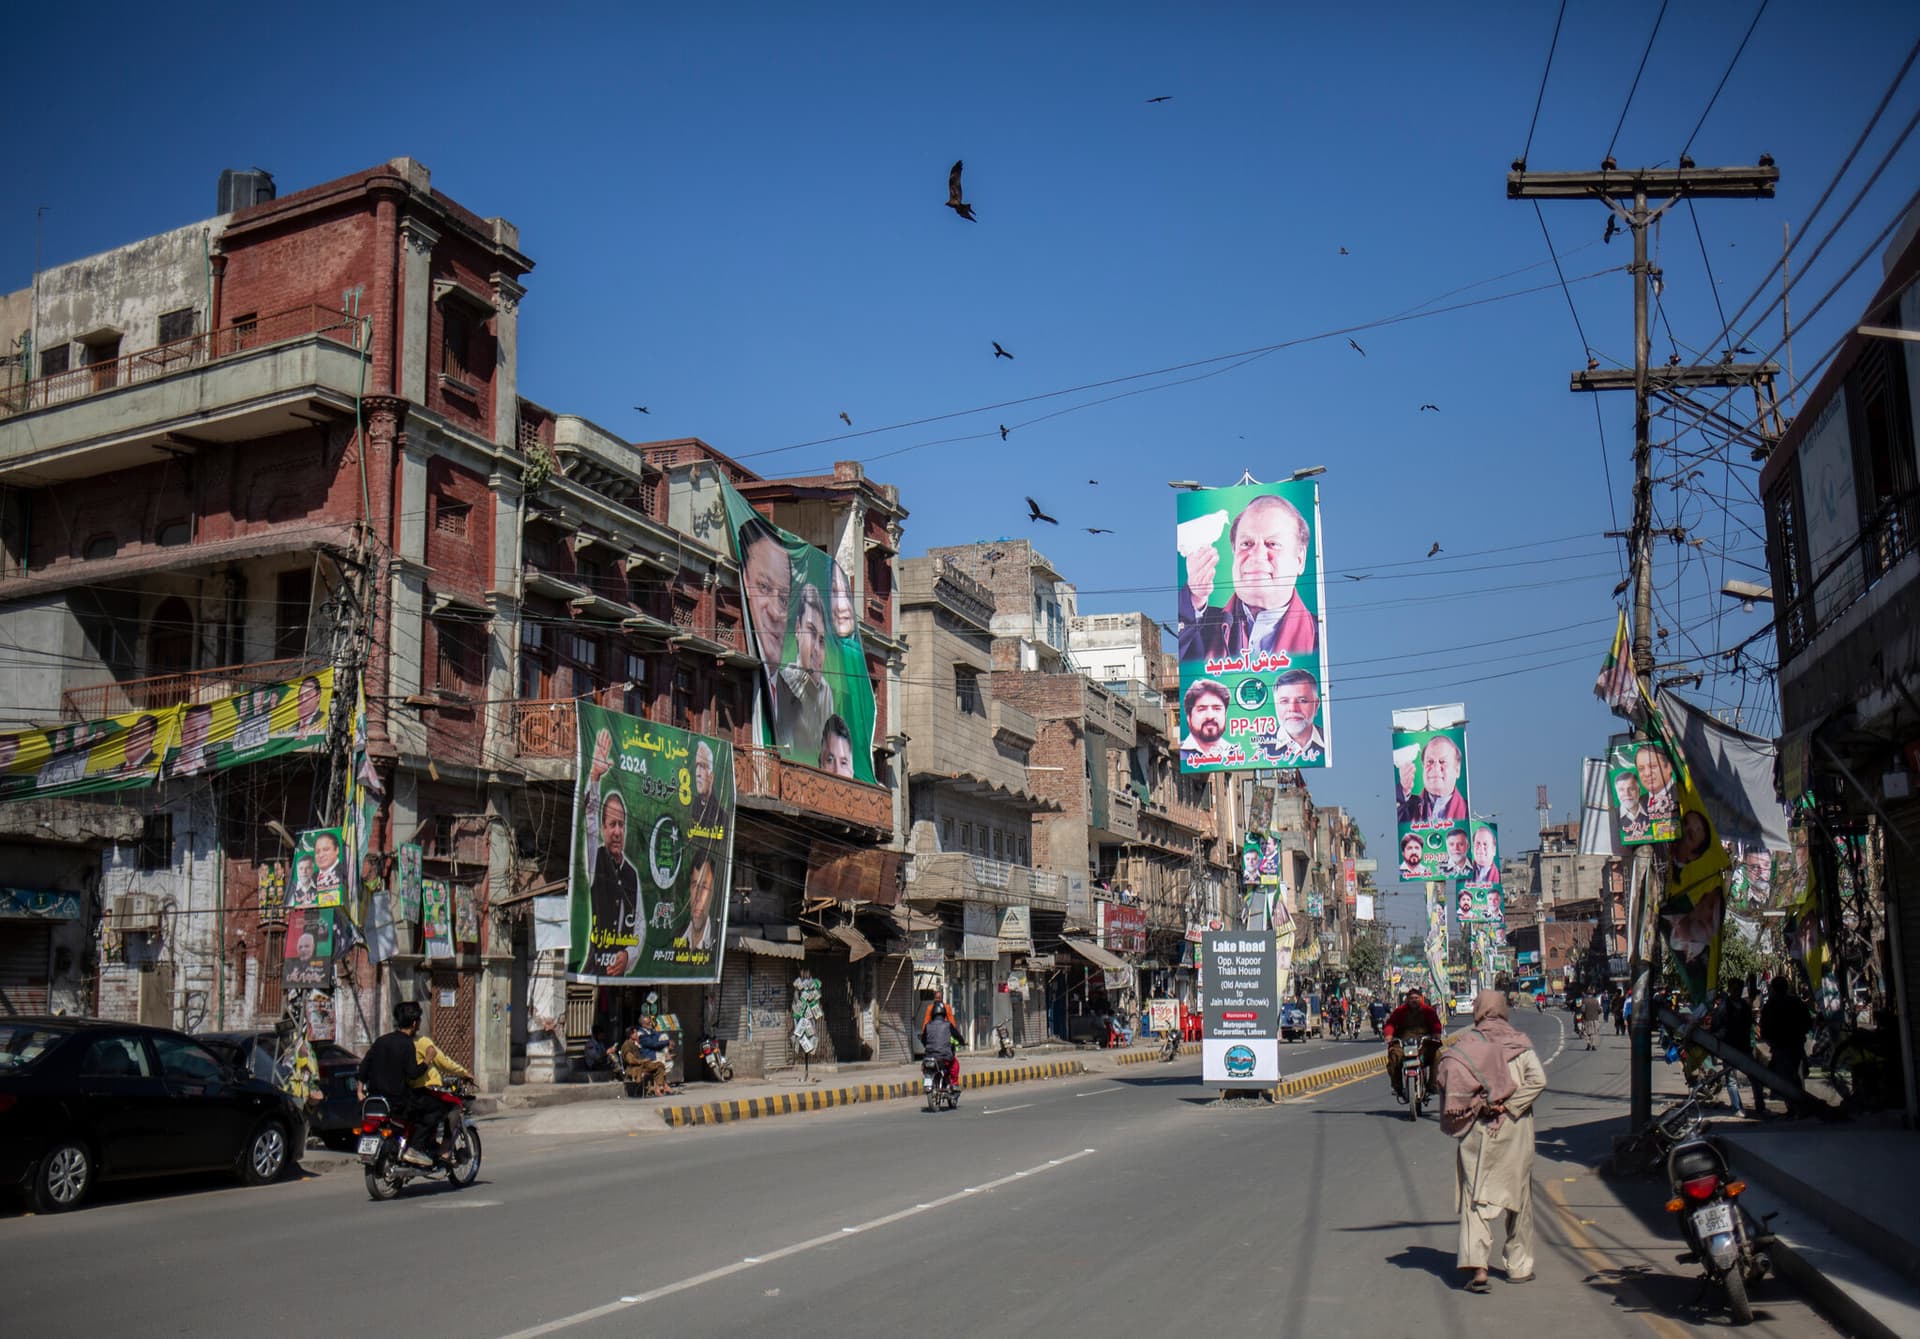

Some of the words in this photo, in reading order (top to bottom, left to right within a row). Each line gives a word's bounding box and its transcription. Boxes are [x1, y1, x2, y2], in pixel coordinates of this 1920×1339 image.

[1205, 650, 1252, 676] آمدید
[1252, 650, 1290, 672] خوش
[1229, 716, 1277, 736] PP-173
[622, 724, 665, 757] الیکشن
[664, 739, 689, 764] جنرل
[619, 754, 647, 775] 2024
[1187, 753, 1223, 767] محمود
[678, 766, 692, 806] 8
[615, 931, 640, 946] محمد
[1212, 941, 1236, 953] Lake
[1238, 941, 1266, 953] Road
[653, 951, 675, 961] PP-173
[1217, 956, 1233, 966] Opp.
[1235, 956, 1261, 966] Kapoor
[1218, 966, 1237, 975] Thala
[1238, 966, 1261, 975] House
[1221, 980, 1233, 990] (Old
[1234, 981, 1259, 989] Anarkali
[1210, 998, 1223, 1007] Jain
[1224, 998, 1245, 1007] Mandir
[1246, 998, 1269, 1008] Chowk)
[1222, 1021, 1257, 1029] Metropolitan
[1247, 1028, 1266, 1036] Lahore
